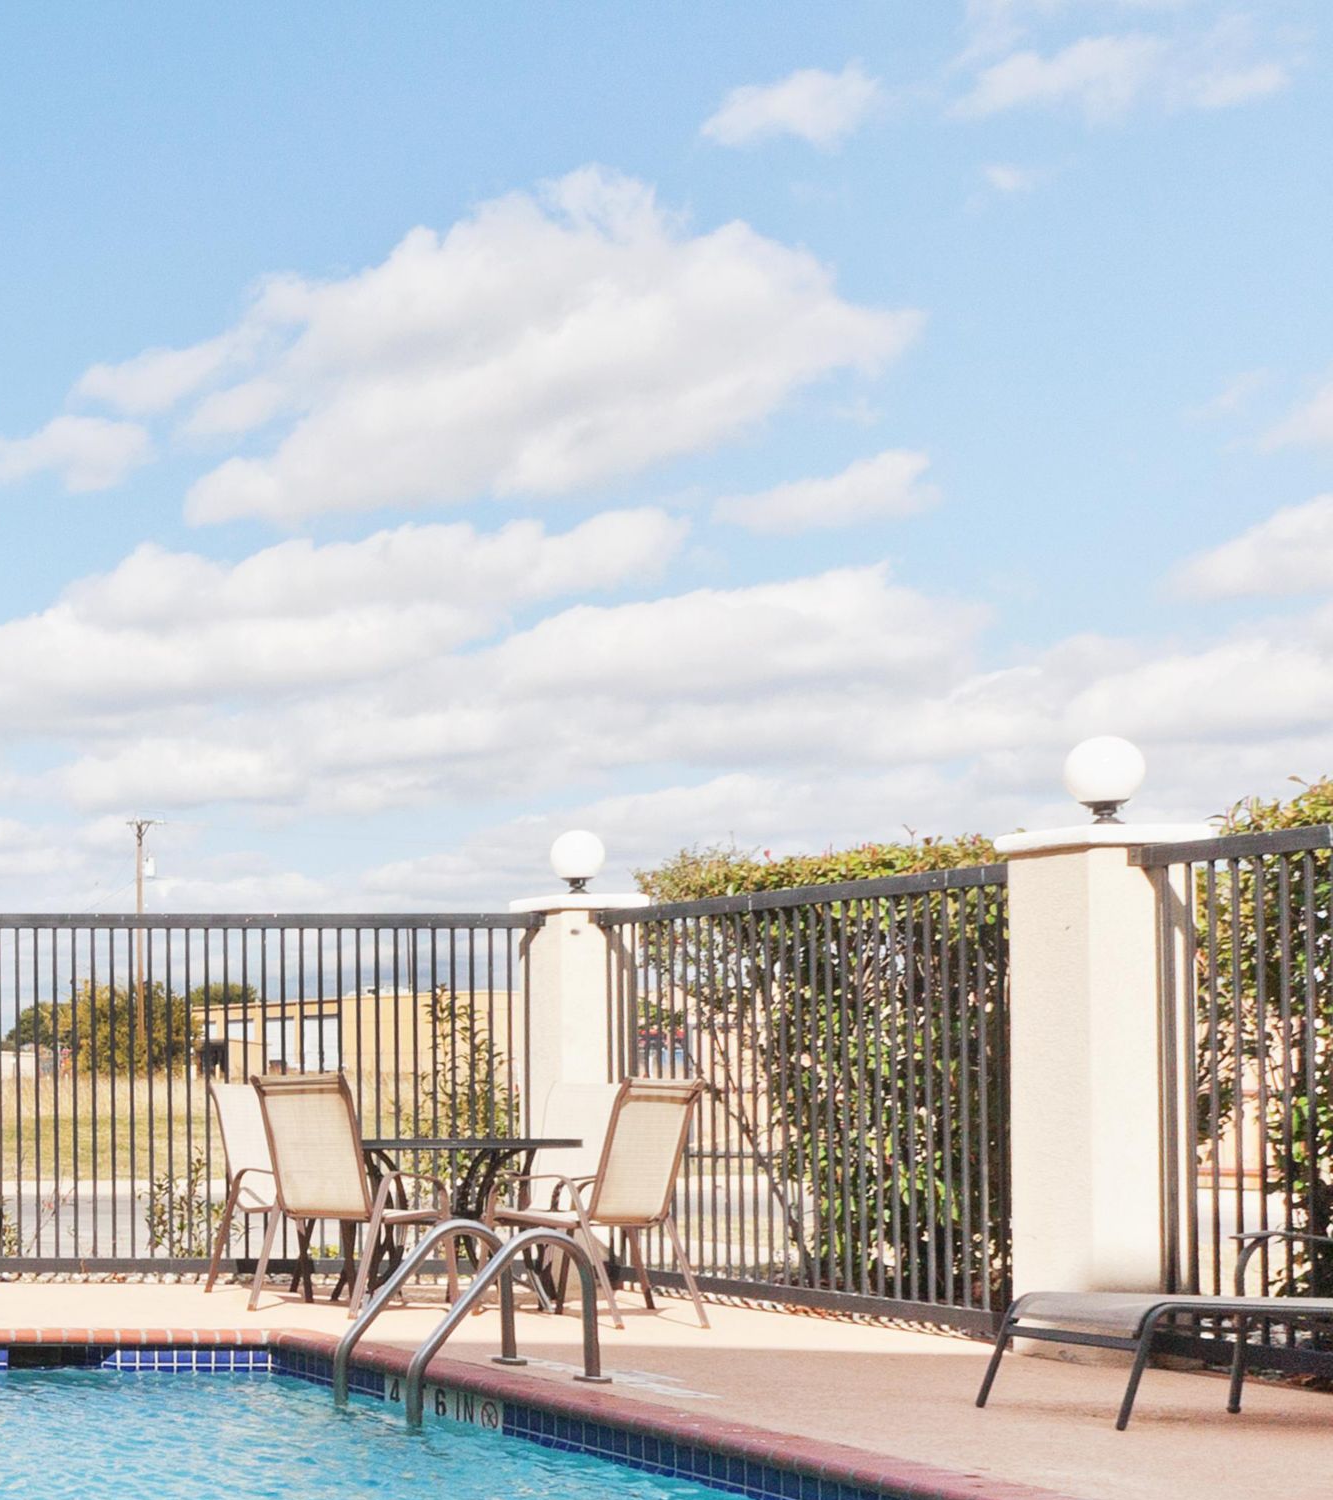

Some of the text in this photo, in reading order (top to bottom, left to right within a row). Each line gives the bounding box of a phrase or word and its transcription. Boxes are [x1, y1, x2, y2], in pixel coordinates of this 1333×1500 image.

[390, 1378, 401, 1403] 4
[435, 1388, 447, 1417] 6
[456, 1391, 475, 1424] IN
